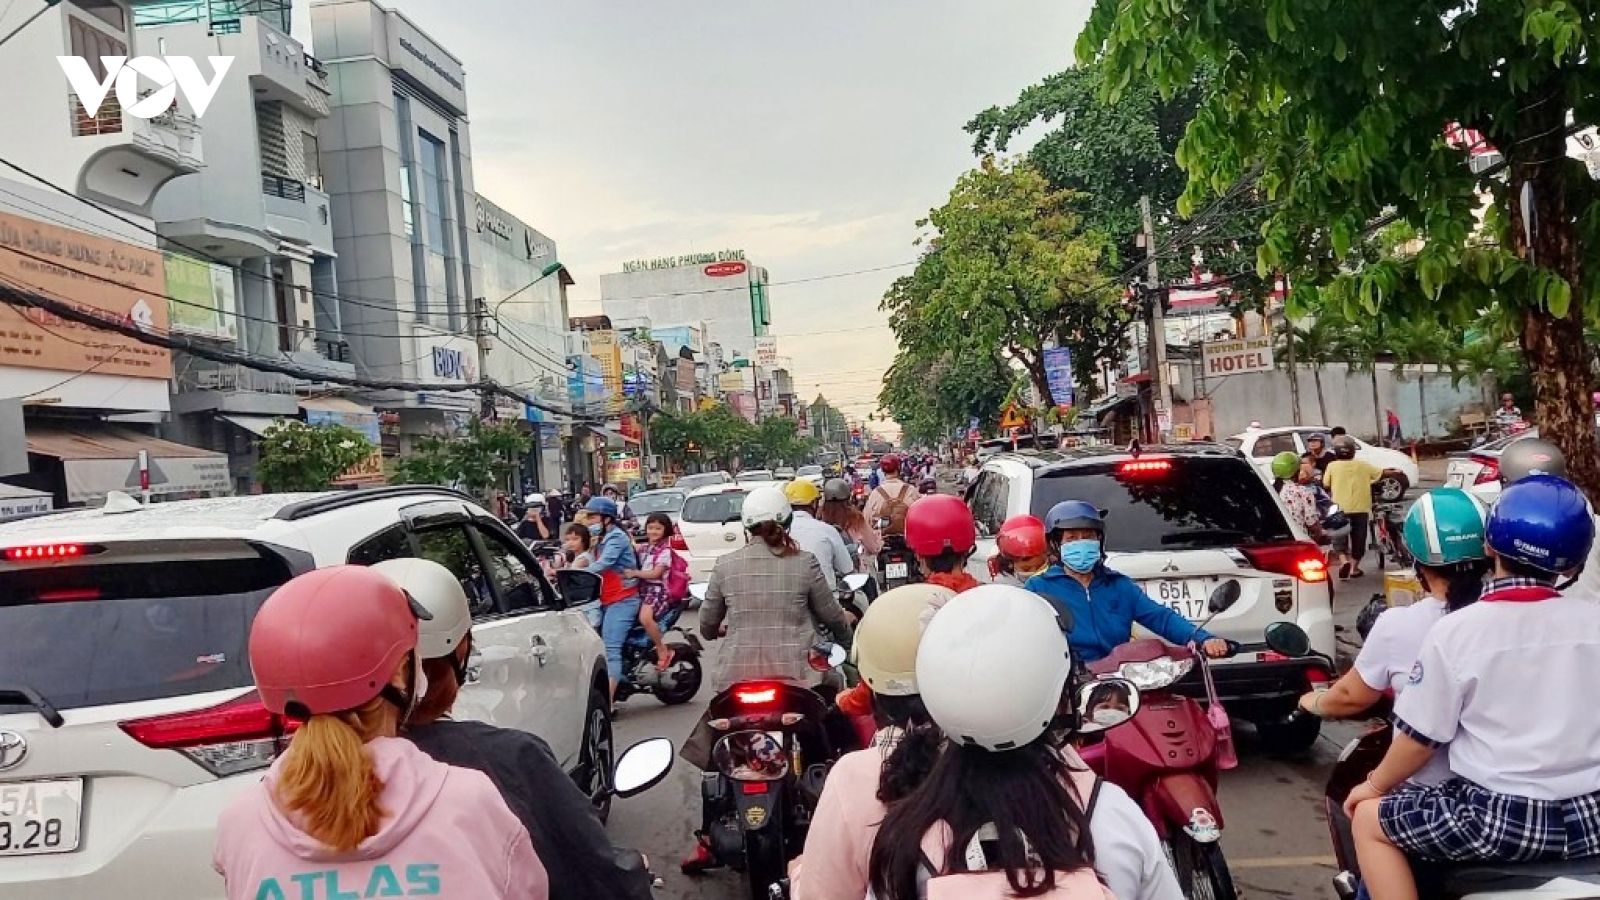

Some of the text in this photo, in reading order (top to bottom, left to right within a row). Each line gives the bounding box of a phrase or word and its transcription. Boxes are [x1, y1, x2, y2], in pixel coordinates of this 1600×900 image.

[622, 258, 648, 273] NGÂN
[651, 255, 676, 271] HÀNG
[1209, 352, 1269, 373] HOTEL
[623, 459, 638, 469] 69
[1520, 542, 1550, 557] YAMAHA
[1159, 581, 1191, 599] 65A
[254, 863, 441, 900] ATLAS
